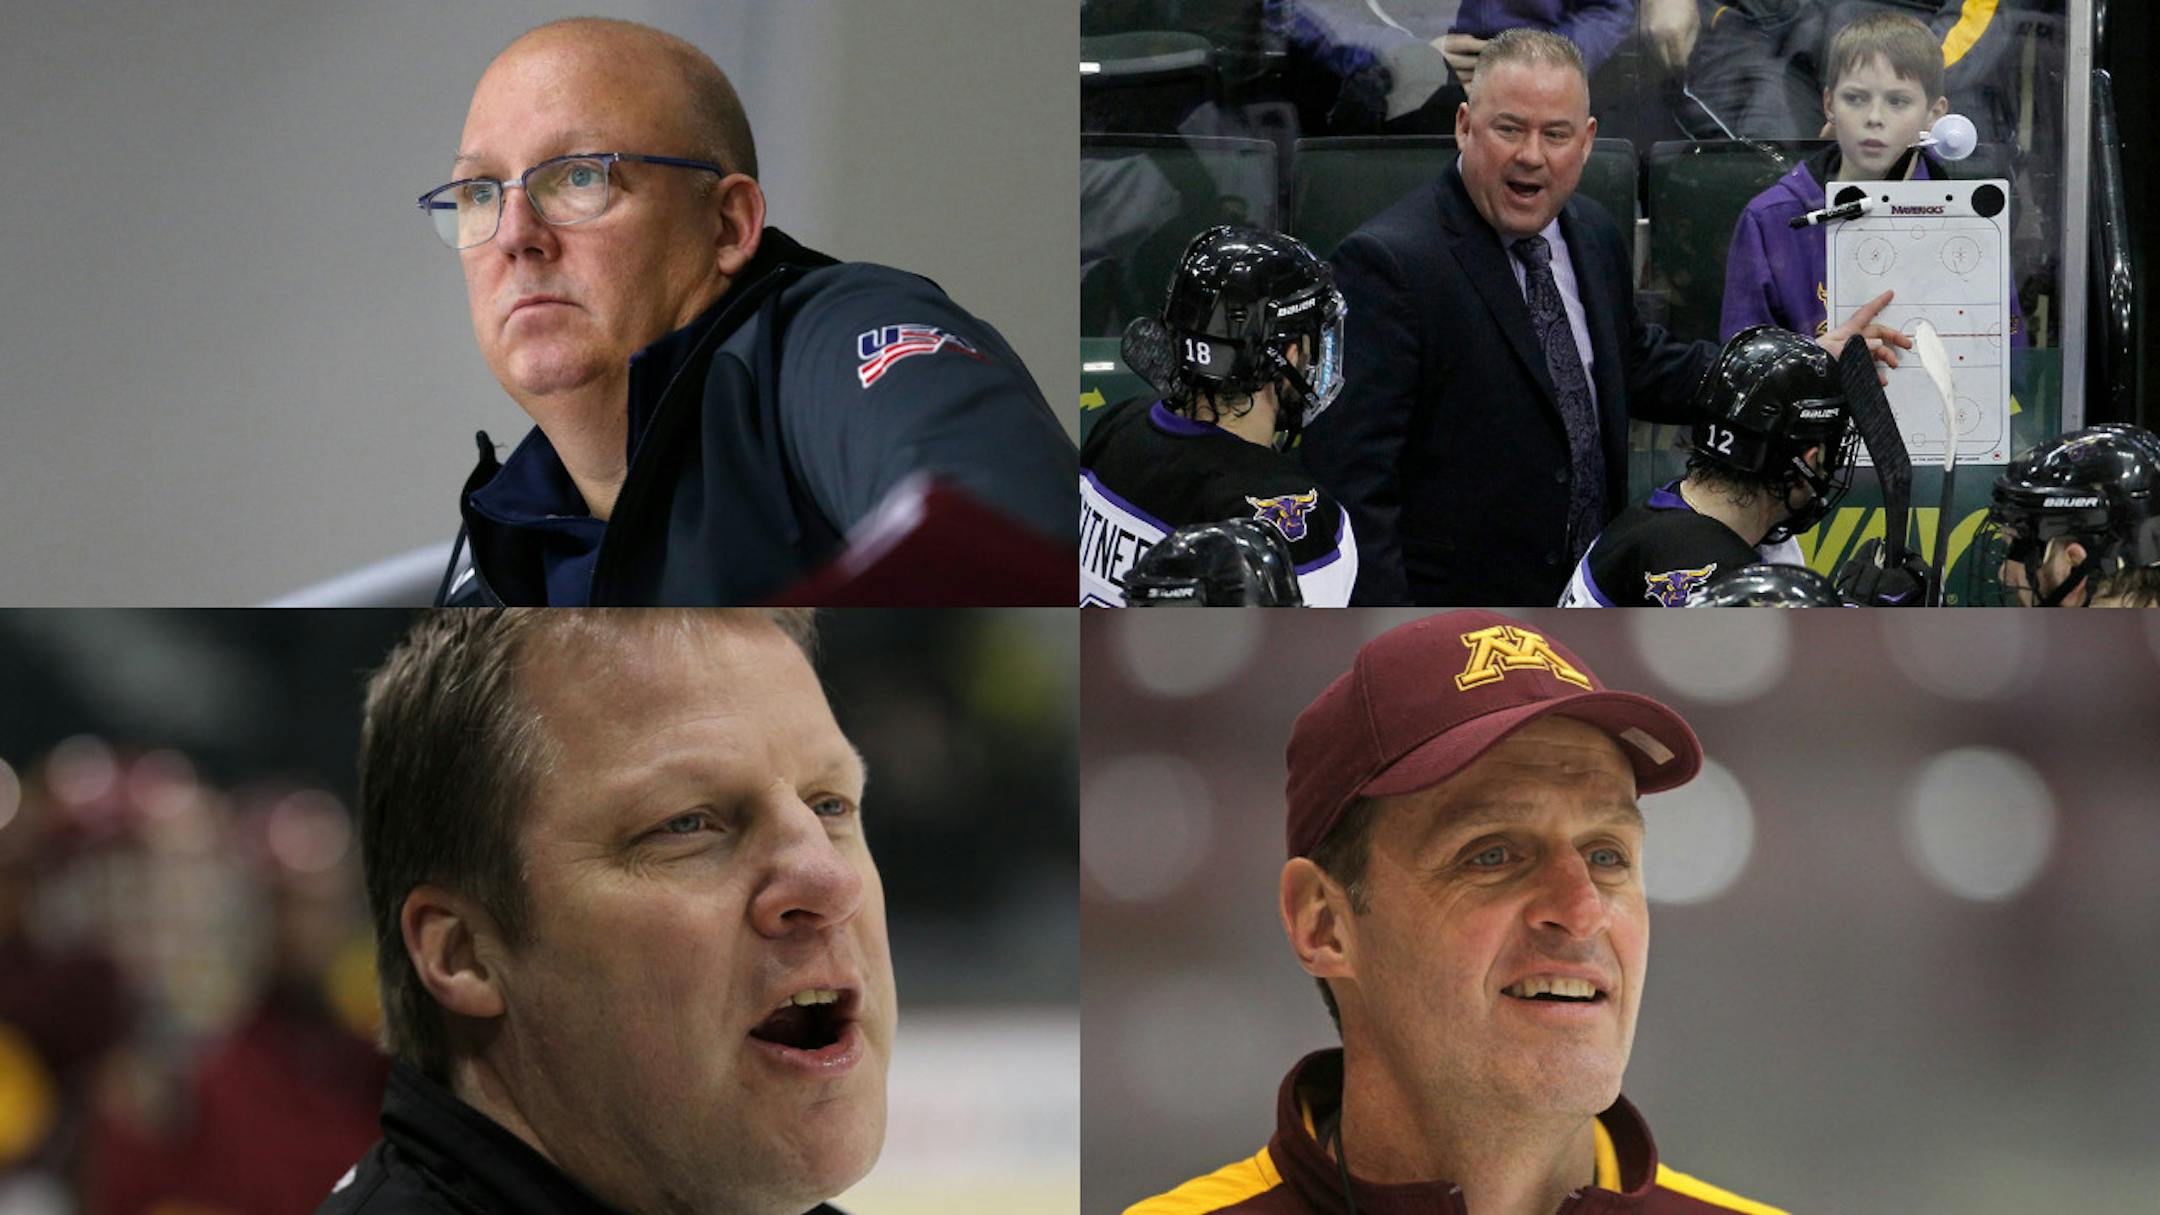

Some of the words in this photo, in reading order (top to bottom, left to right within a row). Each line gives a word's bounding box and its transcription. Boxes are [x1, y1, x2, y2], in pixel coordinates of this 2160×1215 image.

[1890, 204, 1946, 215] MAVERICKS
[1276, 298, 1316, 317] BAUER
[1185, 338, 1211, 365] 18
[1706, 424, 1735, 455] 12
[2042, 497, 2099, 507] BAUER
[1454, 625, 1594, 692] M
